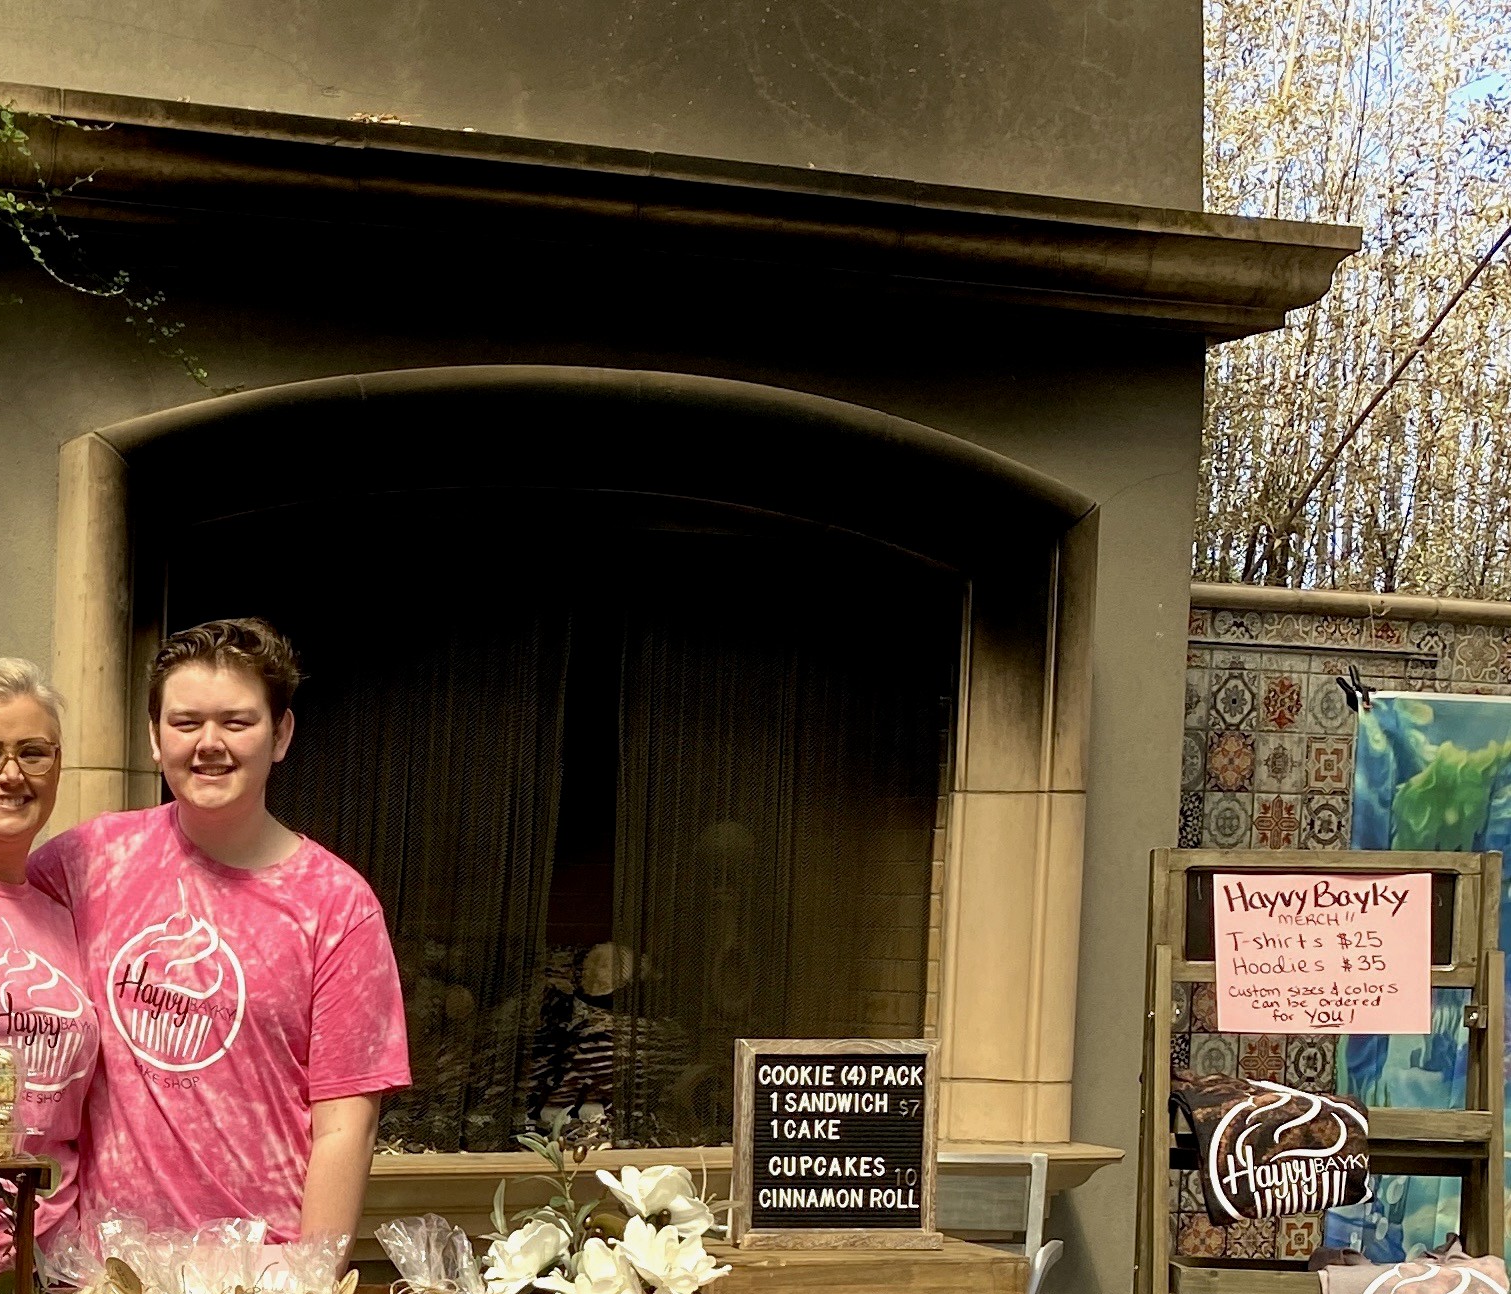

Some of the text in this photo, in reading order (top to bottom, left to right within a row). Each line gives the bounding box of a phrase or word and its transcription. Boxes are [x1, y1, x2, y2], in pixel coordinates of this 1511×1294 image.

[1278, 913, 1339, 926] MERCH
[1226, 931, 1383, 951] T-shirts $25
[1233, 955, 1325, 976] Hoodies
[1228, 984, 1281, 998] Custom
[1288, 984, 1324, 996] sizes
[1345, 982, 1399, 996] colors
[1252, 996, 1381, 1010] can be ordered
[1272, 1009, 1294, 1023] for
[163, 1076, 200, 1090] SHOP
[759, 1065, 923, 1086] COOKIE (4) PACK
[770, 1092, 920, 1118] 1 SANDWICH $7
[770, 1119, 841, 1139] 1 CAKE
[769, 1156, 918, 1187] CUPCAKES 10
[759, 1188, 919, 1209] CINNAMON ROLL
